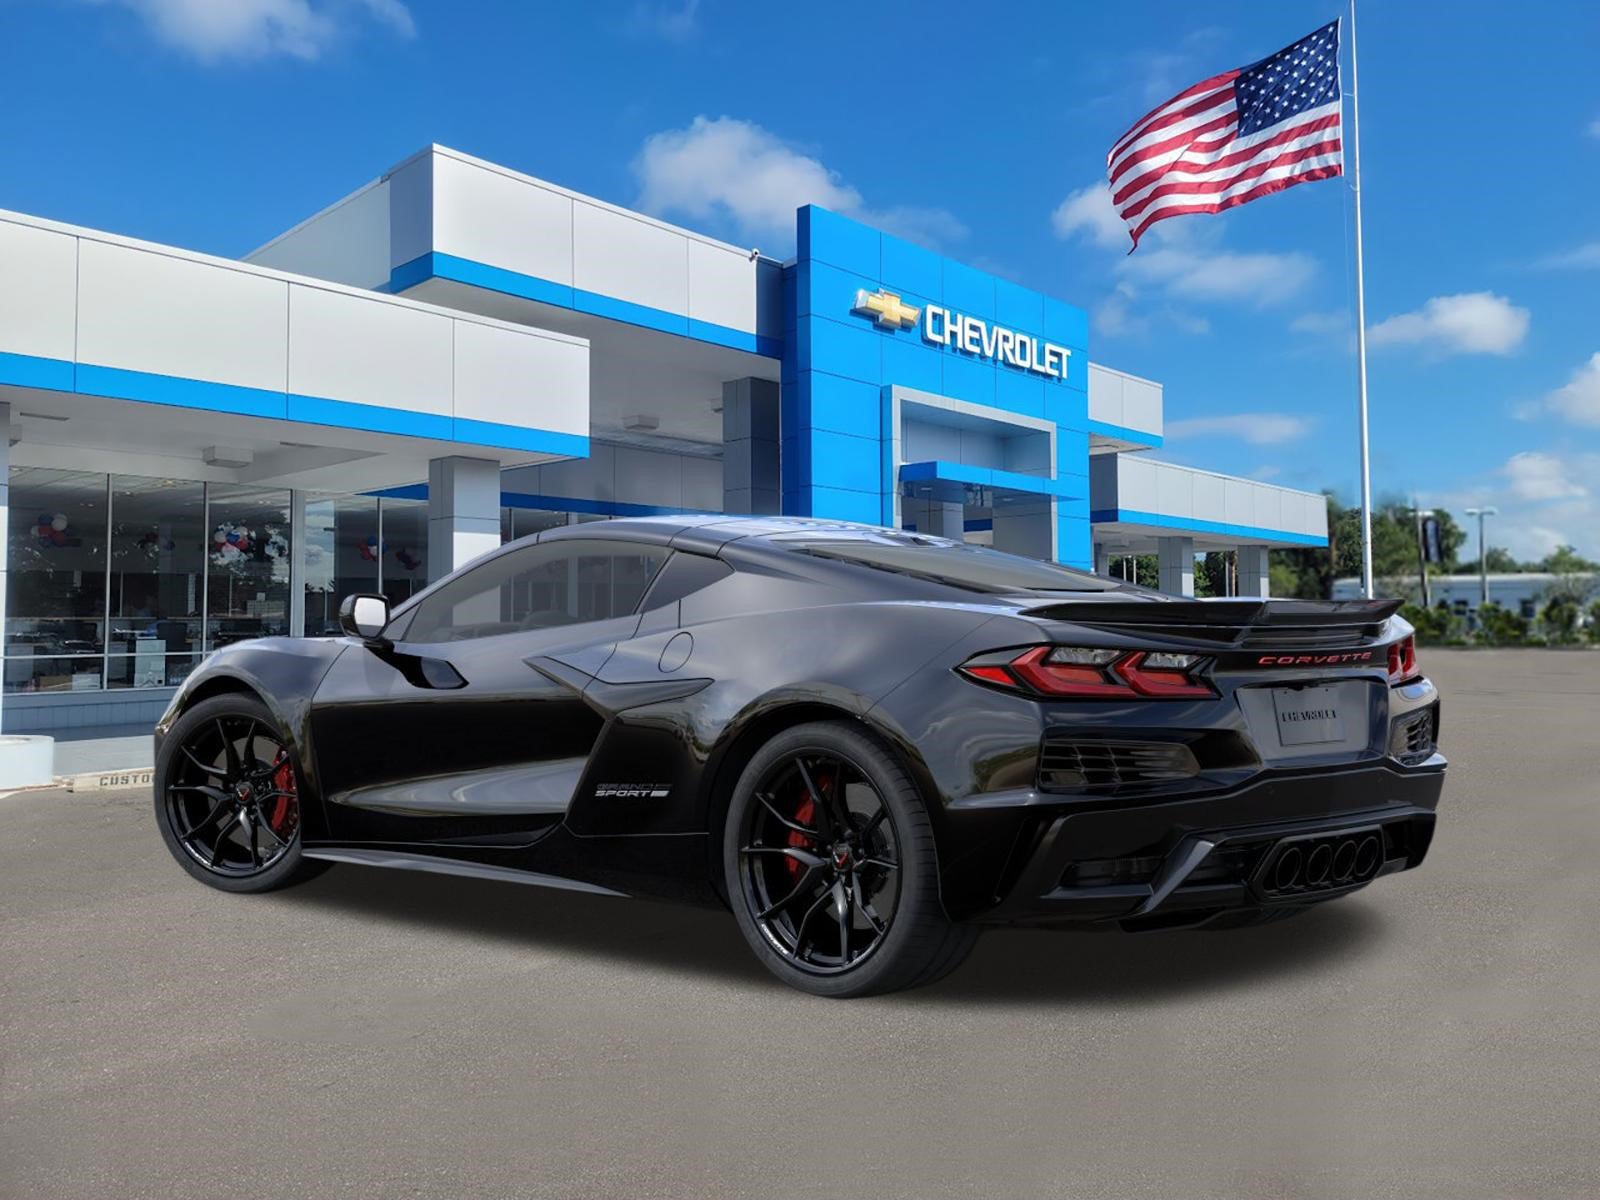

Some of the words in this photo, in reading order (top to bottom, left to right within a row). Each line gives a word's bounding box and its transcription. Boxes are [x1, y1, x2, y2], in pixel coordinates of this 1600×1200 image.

[926, 304, 1072, 379] CHEVROLET
[1258, 651, 1373, 665] CORVETTE
[99, 774, 155, 786] CUSTO
